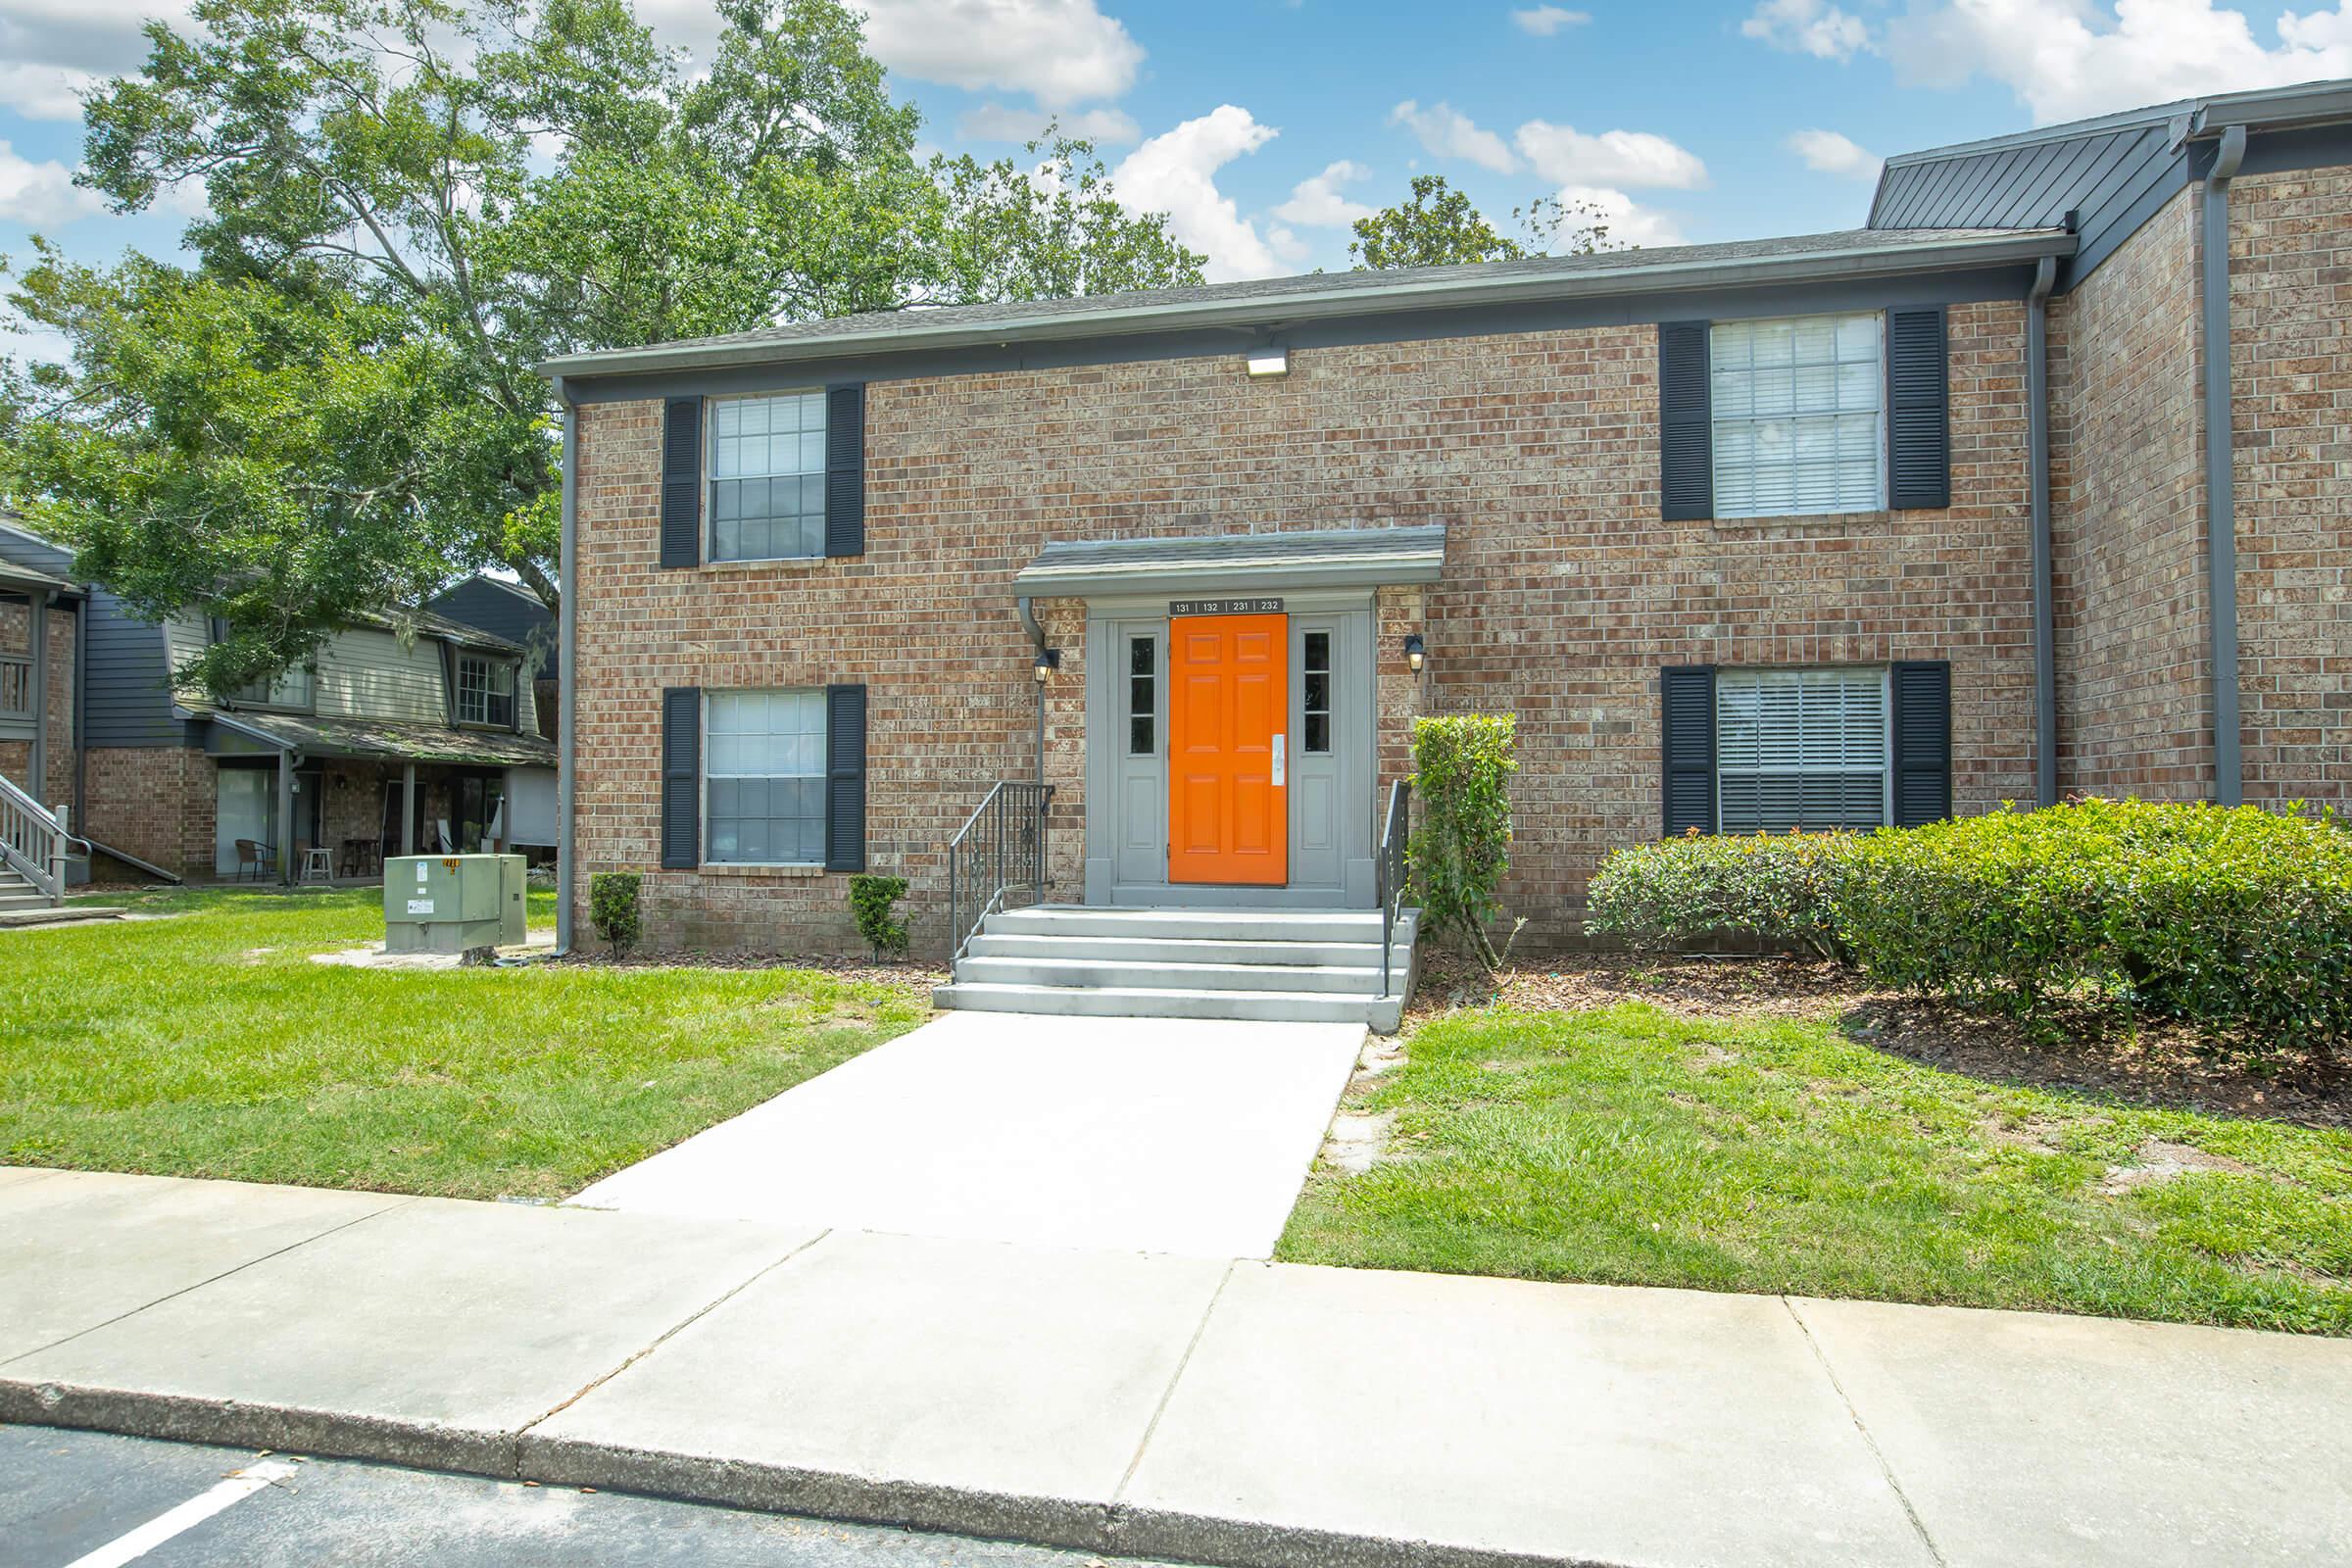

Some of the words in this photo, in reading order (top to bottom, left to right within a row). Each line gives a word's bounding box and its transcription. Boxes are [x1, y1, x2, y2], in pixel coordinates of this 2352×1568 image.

[1176, 604, 1189, 612] 131
[1203, 603, 1218, 612] 132
[1233, 602, 1248, 611] 231
[1261, 601, 1278, 610] 232
